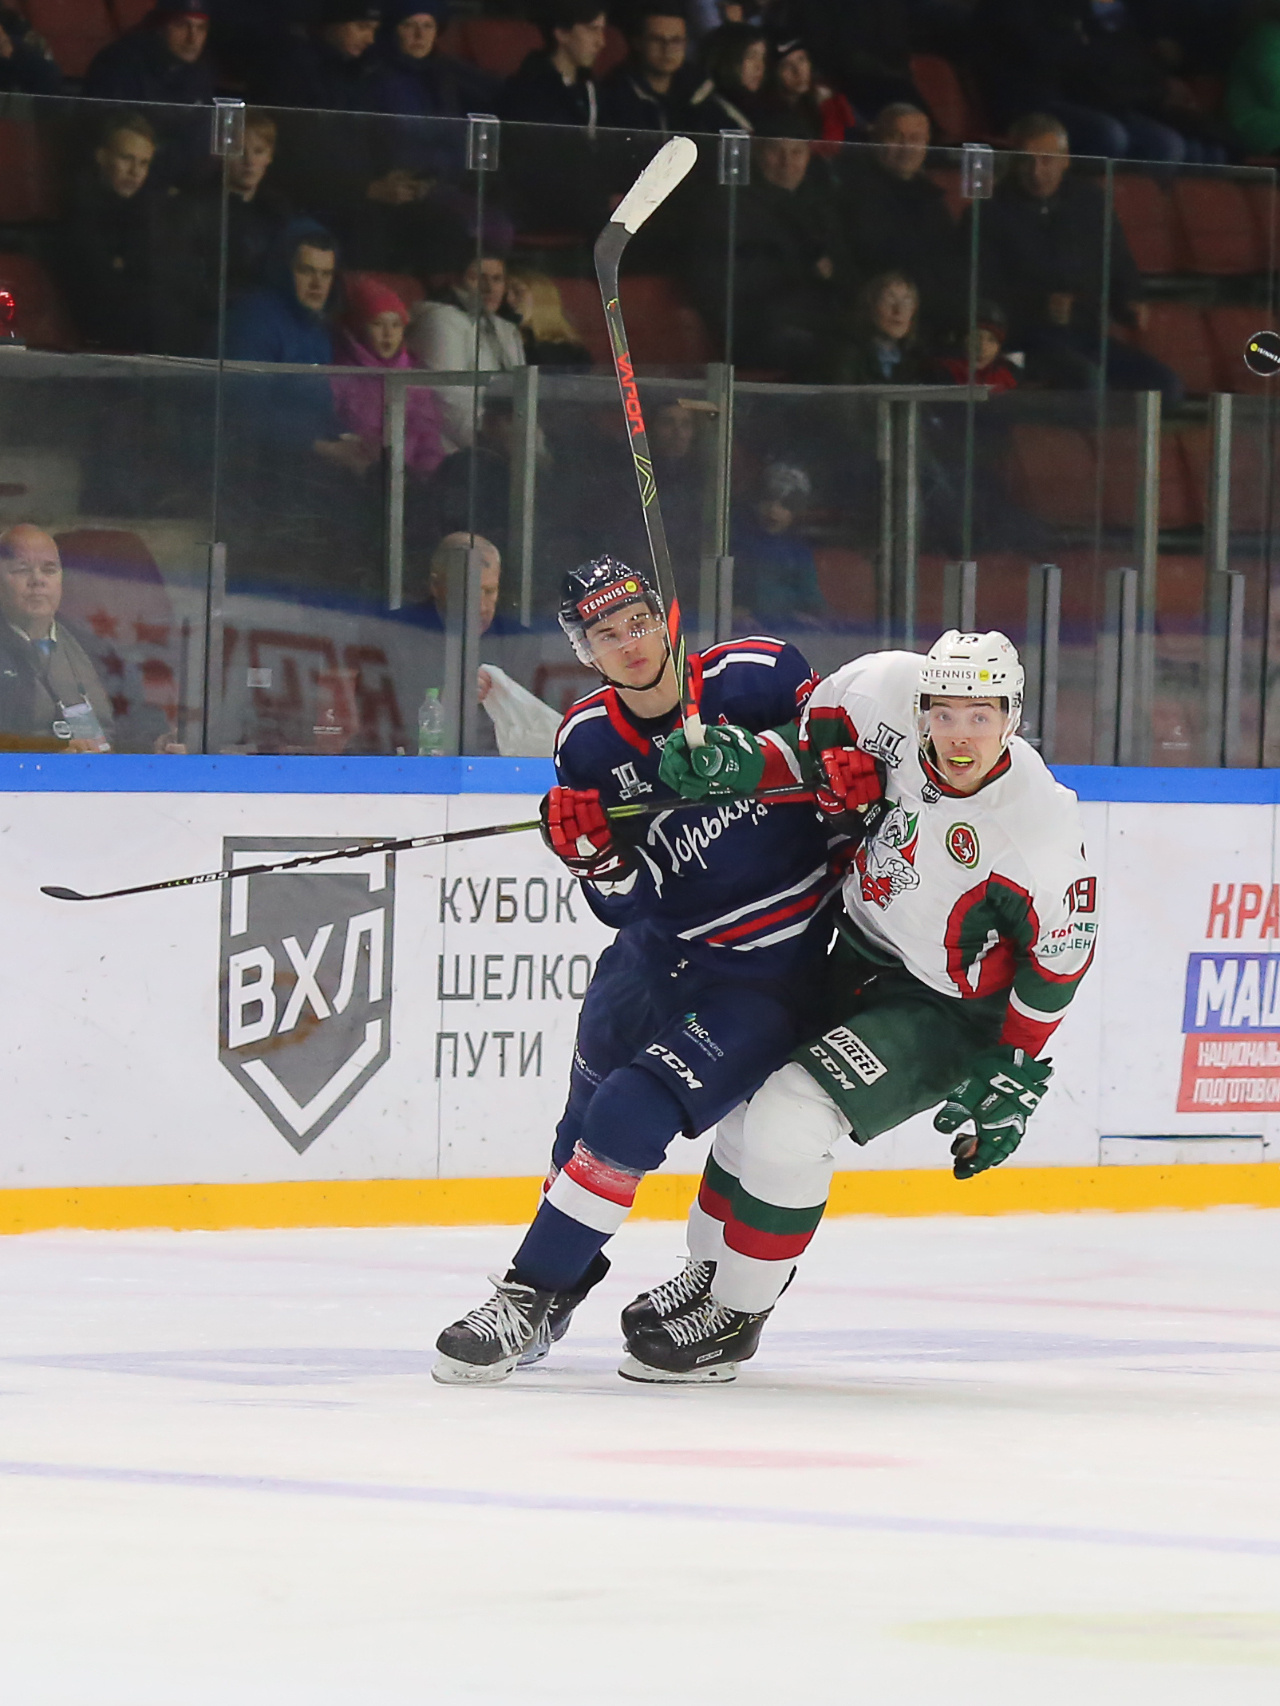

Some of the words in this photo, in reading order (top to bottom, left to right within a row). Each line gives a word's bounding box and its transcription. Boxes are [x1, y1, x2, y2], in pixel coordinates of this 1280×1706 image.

[617, 352, 645, 437] VAPOR
[583, 586, 626, 614] TENNISI
[930, 669, 976, 680] TENNISI
[439, 877, 578, 923] КУБОК
[229, 907, 385, 1049] ВХЛ
[437, 954, 591, 1000] ШЕЛКО
[435, 1032, 543, 1077] ПУТИ
[645, 1043, 703, 1089] CCM
[809, 1044, 856, 1090] CCM
